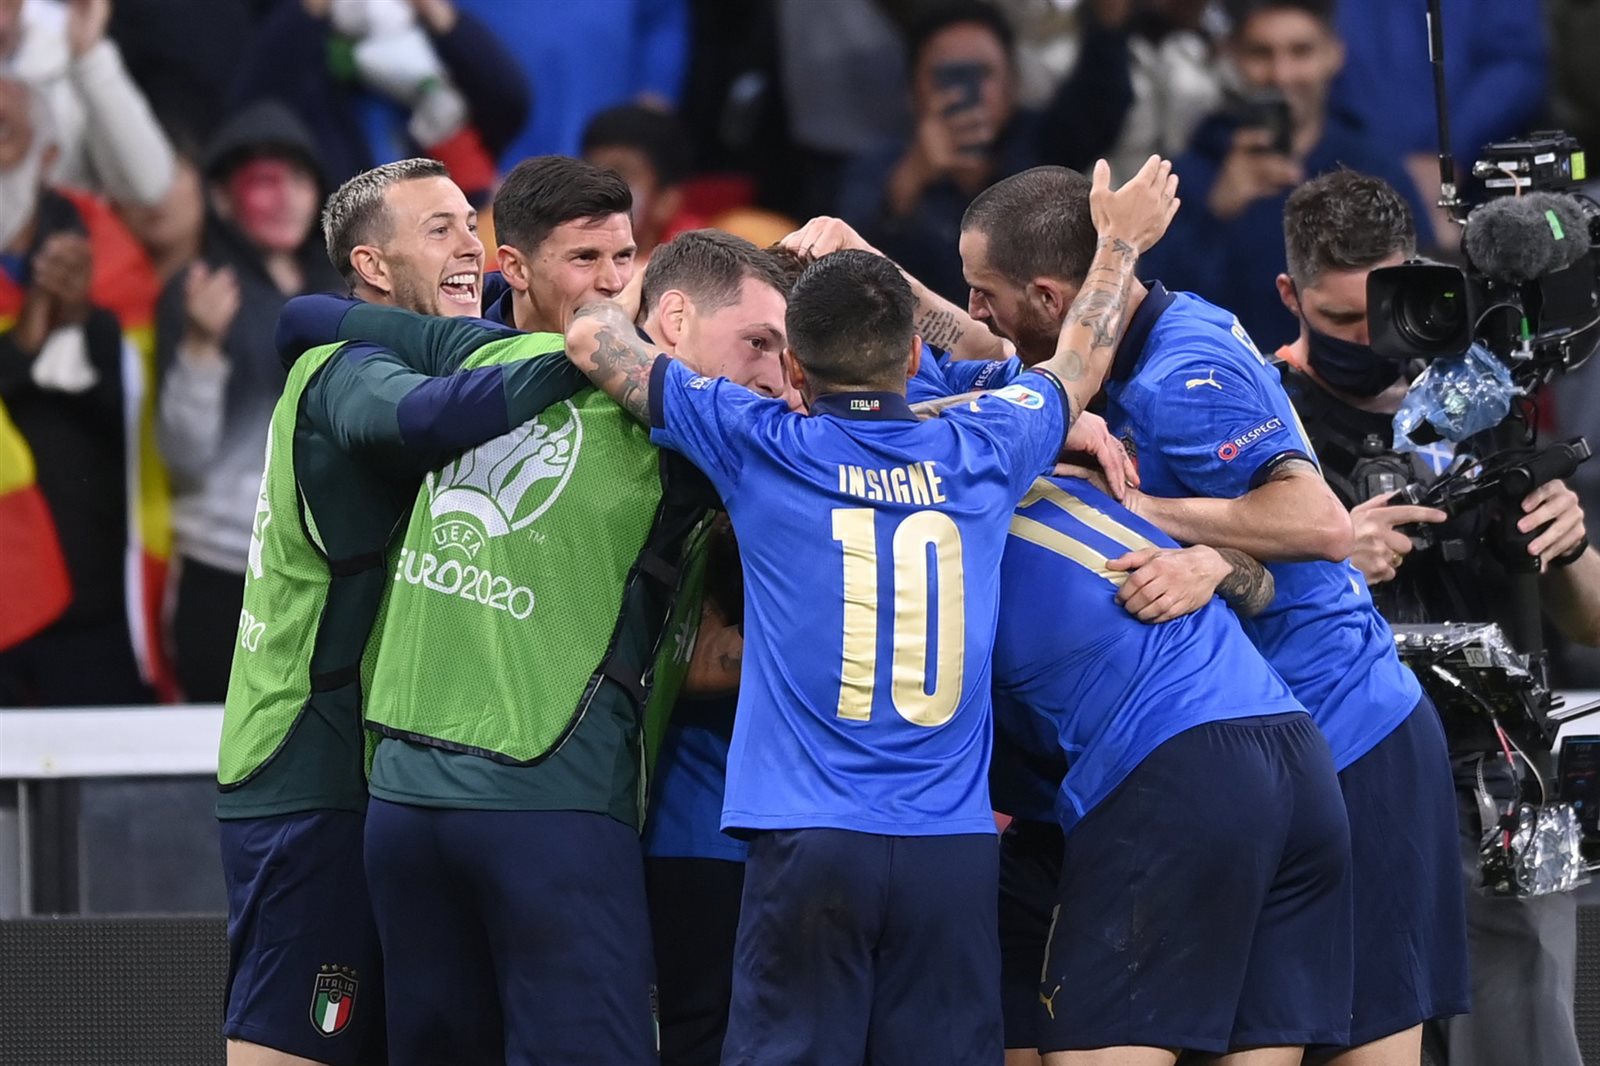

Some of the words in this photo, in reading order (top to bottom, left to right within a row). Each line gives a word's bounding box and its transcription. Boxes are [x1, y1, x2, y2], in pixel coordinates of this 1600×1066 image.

[850, 399, 880, 408] ITALIA
[1234, 417, 1283, 448] RESPECT
[838, 460, 947, 506] INSIGNE
[433, 525, 482, 558] UEFA
[831, 508, 965, 727] 10
[320, 978, 354, 993] ITALIA
